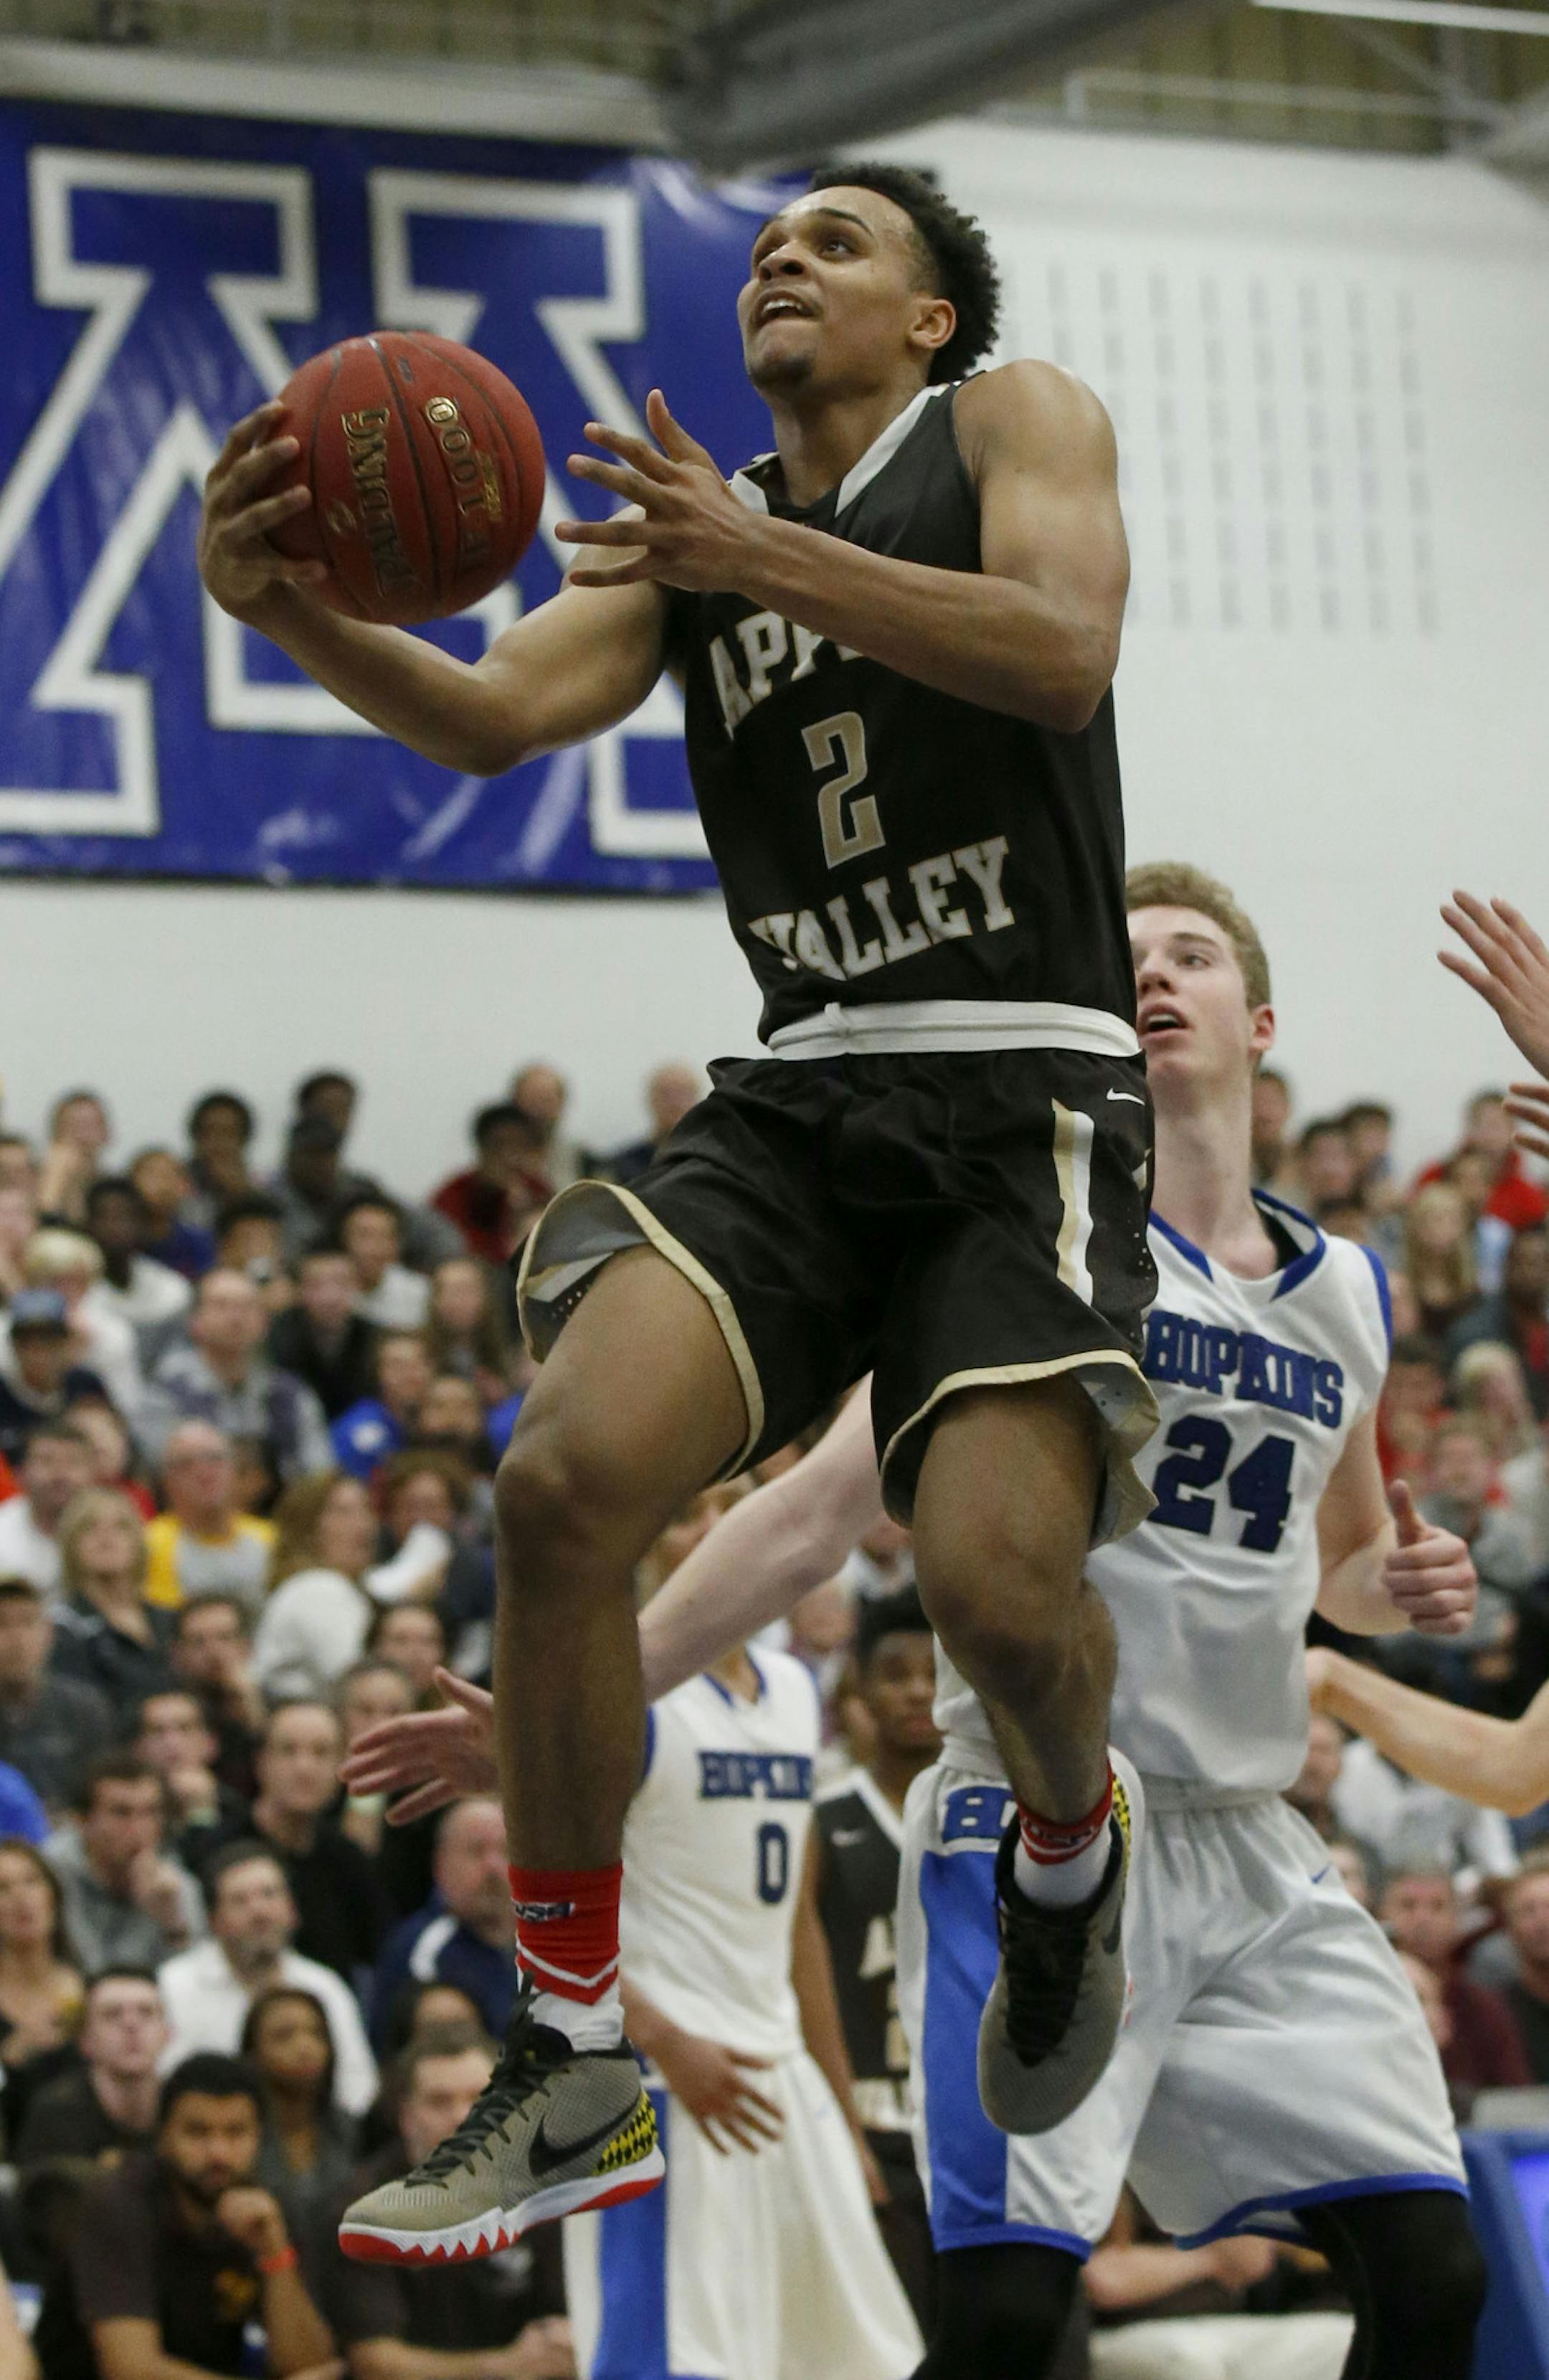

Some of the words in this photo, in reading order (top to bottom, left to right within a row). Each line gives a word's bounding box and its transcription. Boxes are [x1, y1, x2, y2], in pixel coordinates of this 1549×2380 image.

[341, 407, 416, 598] PALDING
[709, 609, 865, 742] APP
[801, 710, 886, 870] 2
[747, 834, 1016, 982] VALLEY
[1142, 1309, 1345, 1430] HOPKINS
[1146, 1414, 1296, 1554] 24
[697, 1749, 814, 1800] HOPKIN
[756, 1821, 789, 1906] 0
